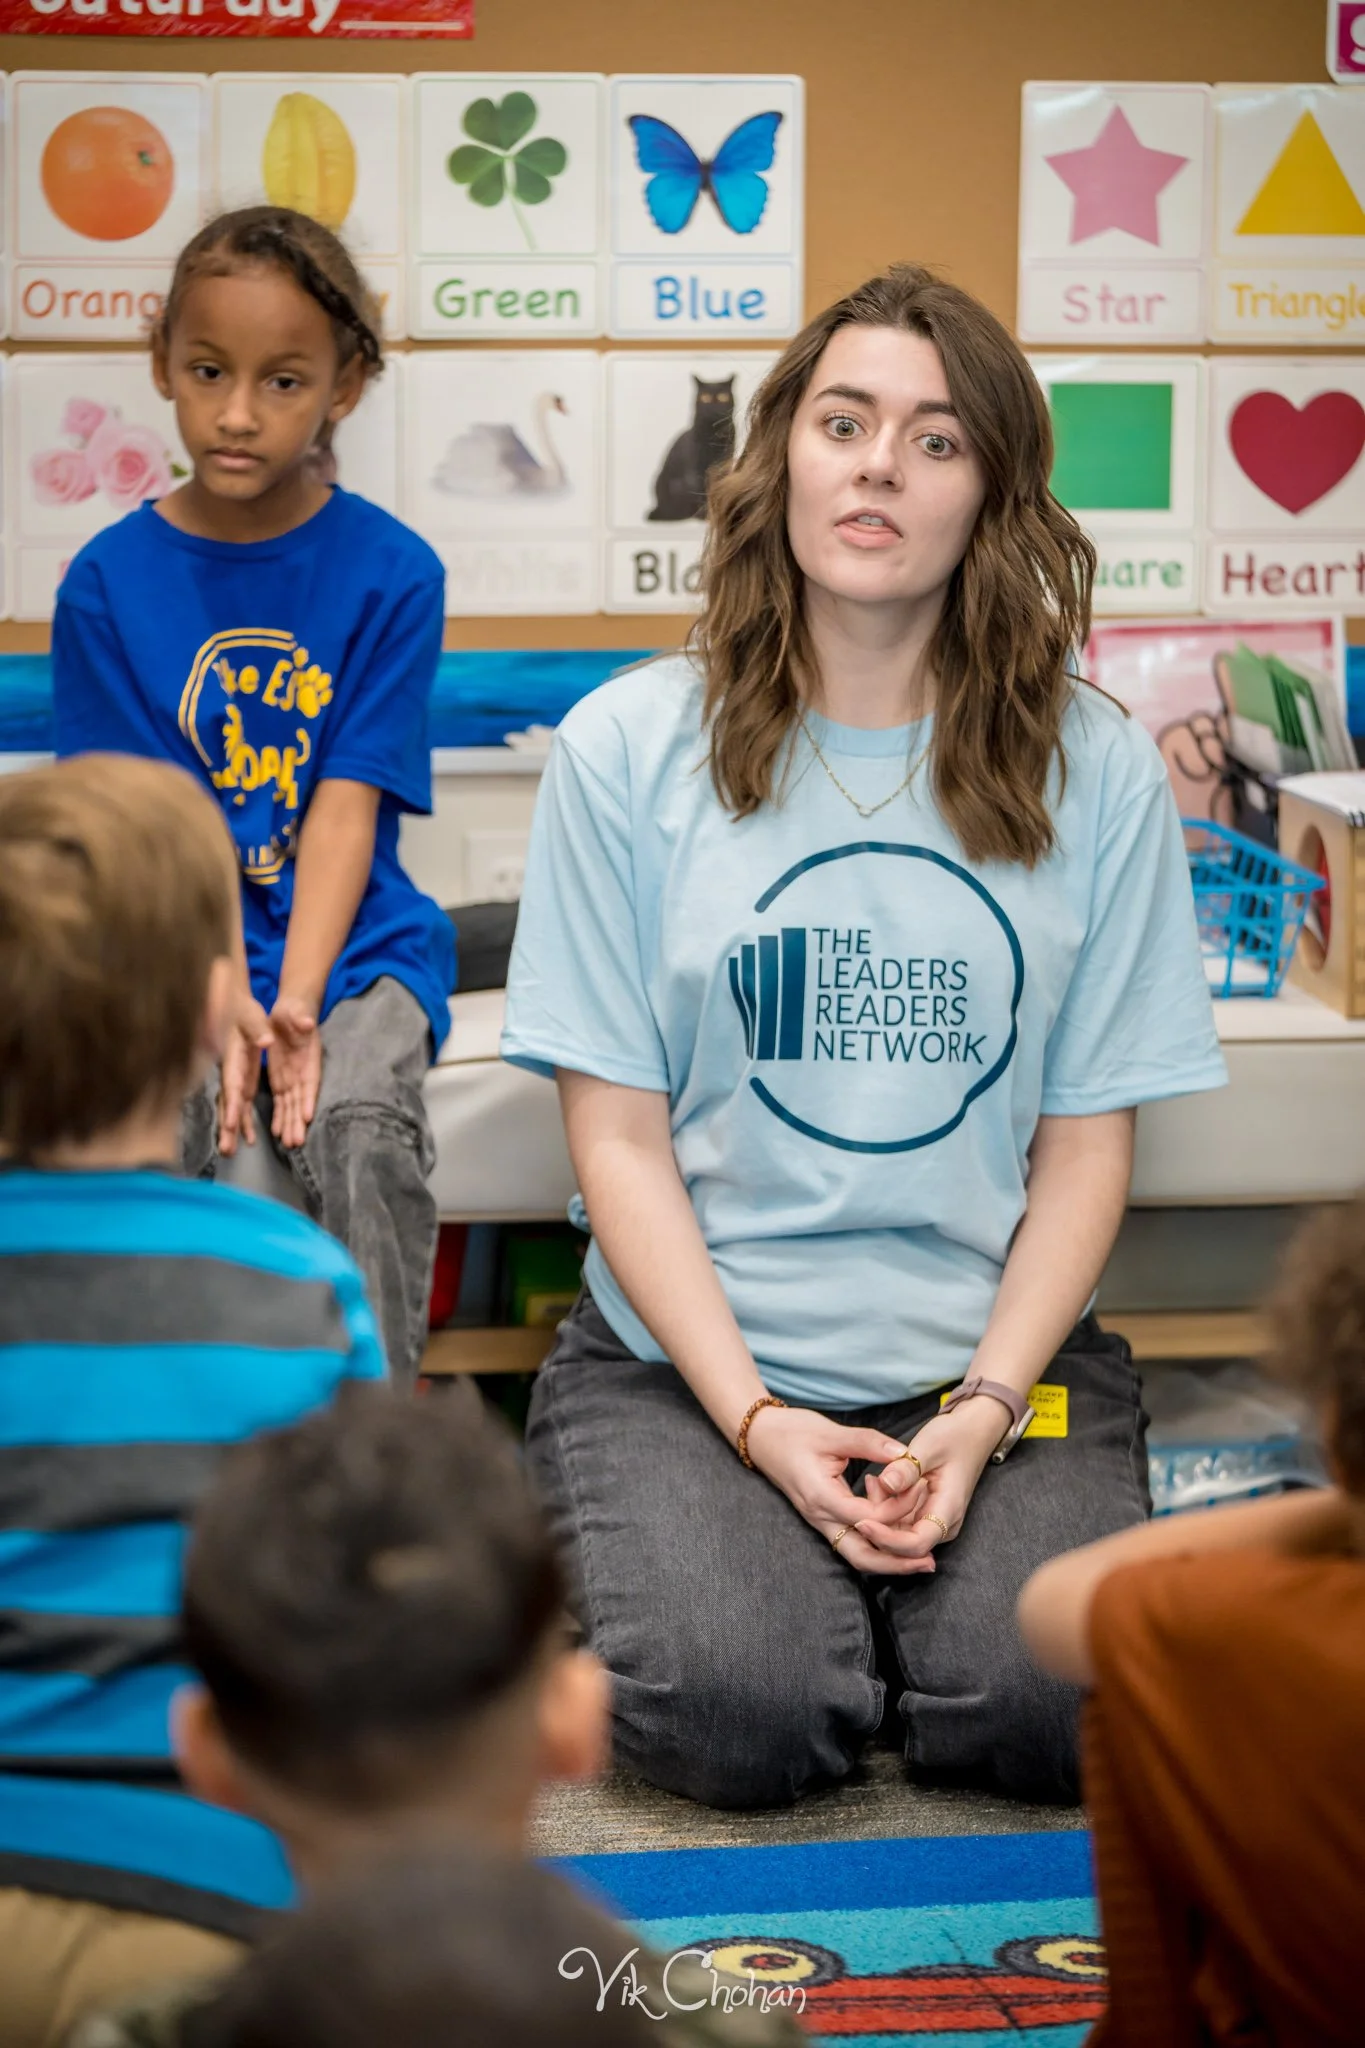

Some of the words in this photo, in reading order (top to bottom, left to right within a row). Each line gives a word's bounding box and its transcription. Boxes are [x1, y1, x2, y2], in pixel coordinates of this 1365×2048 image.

[22, 280, 166, 331] Orang
[433, 278, 580, 319] Green
[653, 274, 768, 320] Blue
[1062, 283, 1167, 324] Star
[632, 550, 706, 595] Bla
[1092, 557, 1185, 589] uare
[812, 928, 872, 954] THE
[817, 958, 968, 991] LEADERS
[816, 994, 968, 1026] READERS
[813, 1030, 988, 1065] NETWORK
